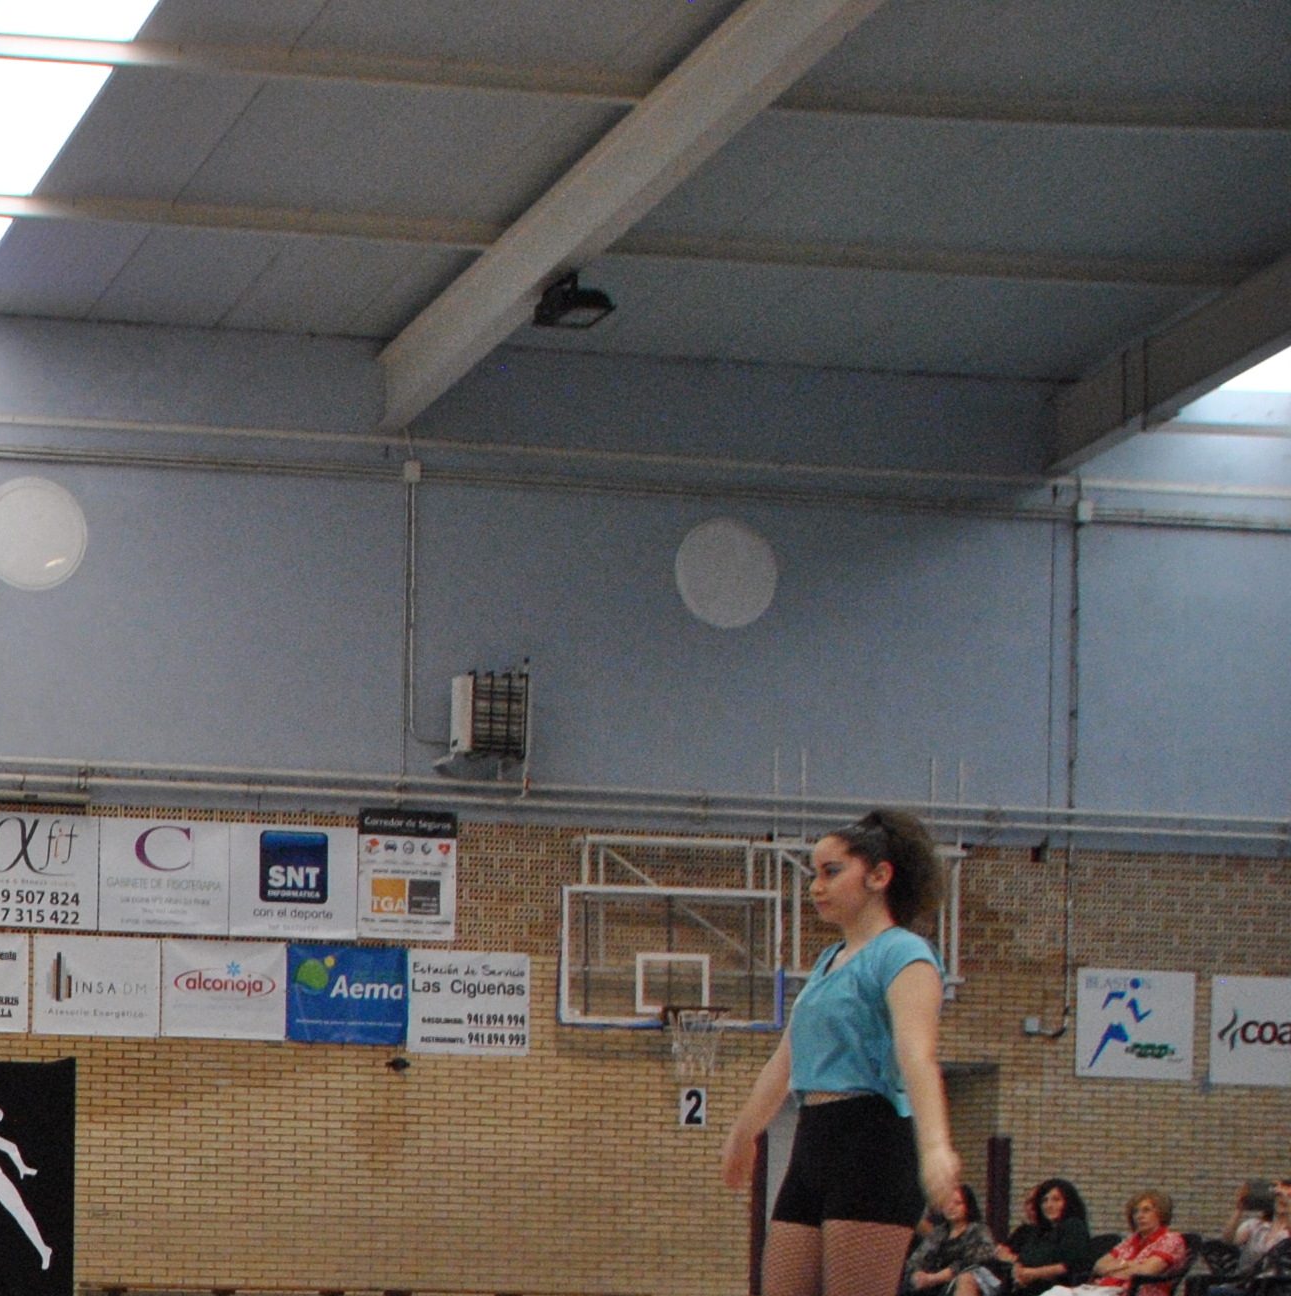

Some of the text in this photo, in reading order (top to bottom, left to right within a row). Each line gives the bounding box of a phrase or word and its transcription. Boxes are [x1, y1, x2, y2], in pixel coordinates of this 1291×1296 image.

[268, 865, 321, 889] SNT
[16, 889, 45, 905] 507
[50, 891, 80, 906] 824
[15, 908, 45, 923] 315
[49, 910, 79, 925] 422
[253, 907, 333, 920] con el deporte
[413, 961, 525, 977] Estación de Servicio
[75, 981, 147, 996] INSA DM
[185, 971, 263, 997] alconoja
[412, 978, 441, 993] Las
[467, 1013, 483, 1025] 941
[486, 1013, 504, 1026] 894
[507, 1014, 525, 1026] 994
[468, 1032, 484, 1044] 941
[487, 1033, 505, 1045] 894
[508, 1033, 526, 1046] 993
[684, 1089, 703, 1125] 2
